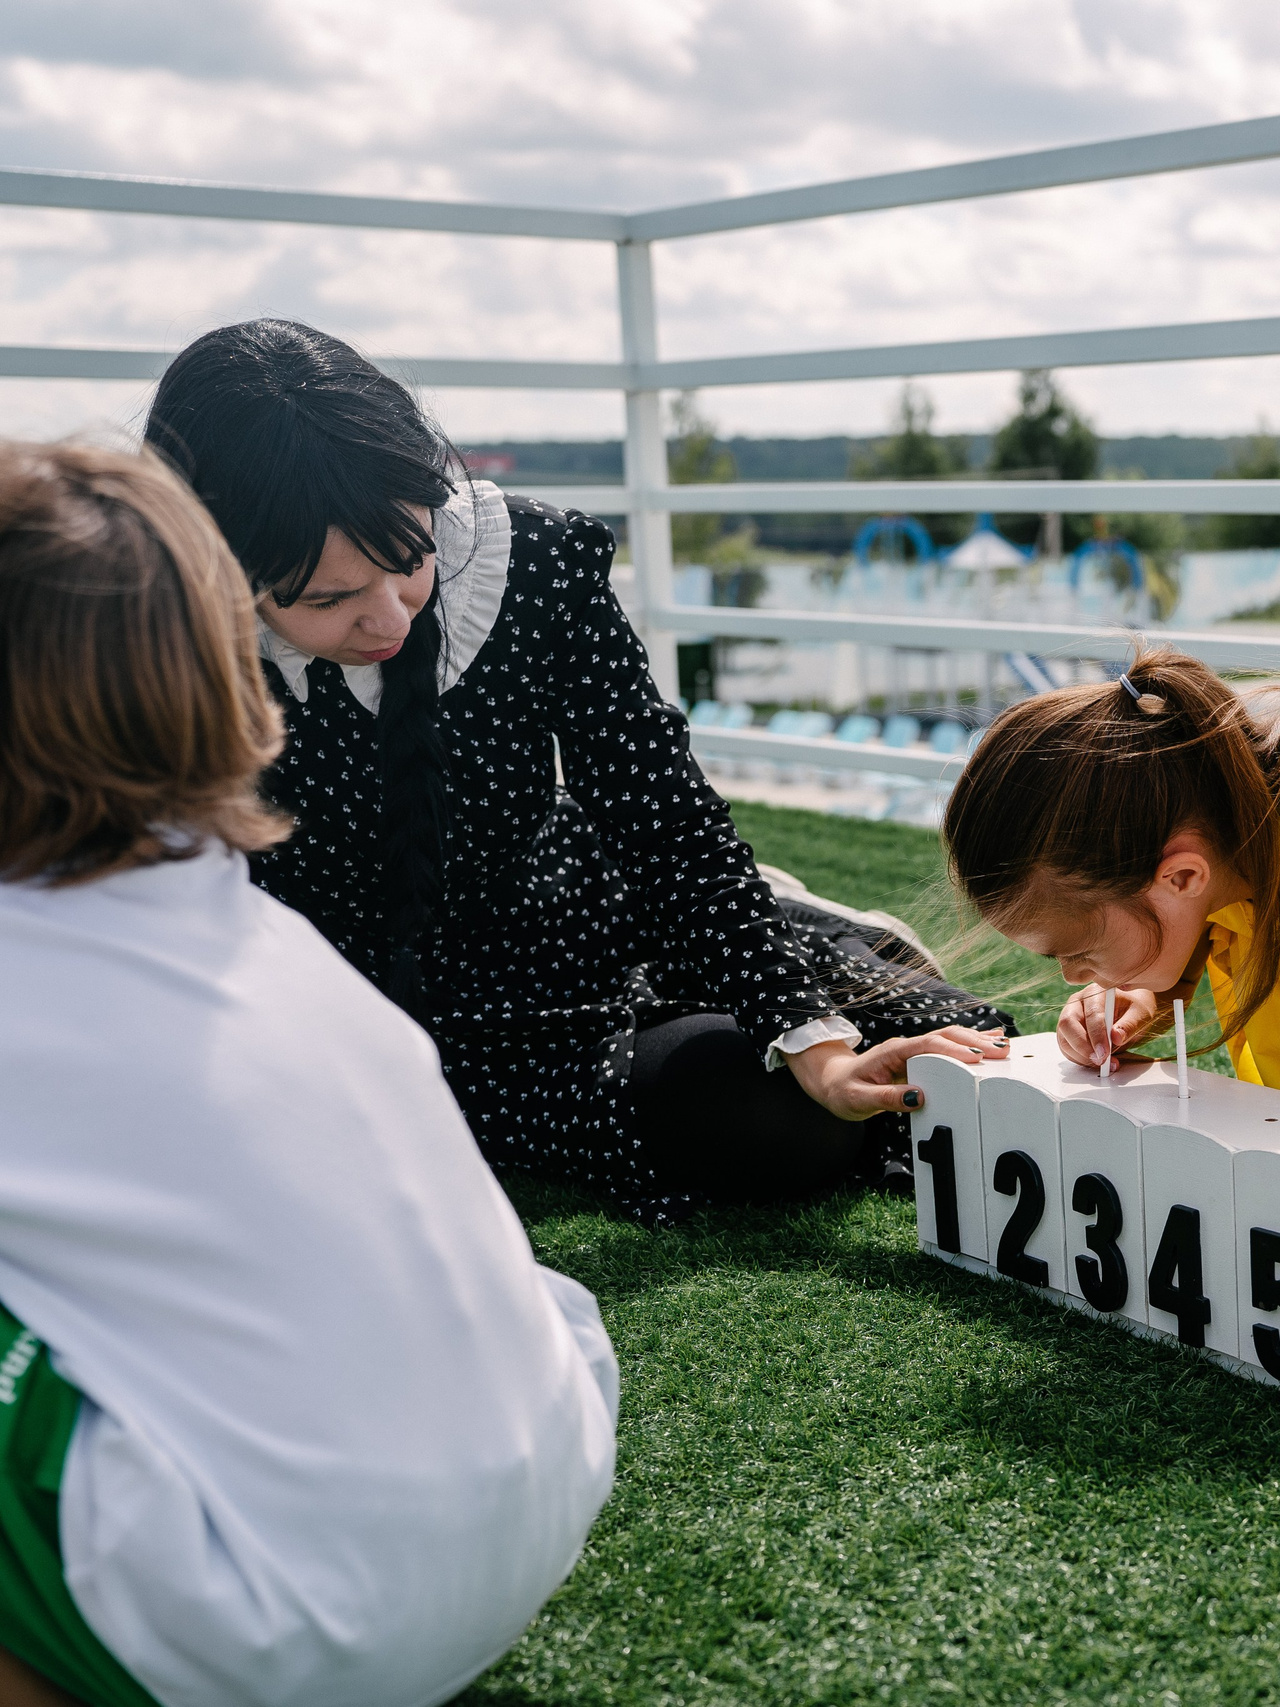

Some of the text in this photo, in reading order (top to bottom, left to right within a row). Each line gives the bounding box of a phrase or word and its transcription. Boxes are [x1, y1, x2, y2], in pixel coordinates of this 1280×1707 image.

[918, 1125, 961, 1254] 1
[993, 1150, 1049, 1288] 2
[1072, 1173, 1128, 1312] 3
[1148, 1204, 1211, 1348] 4
